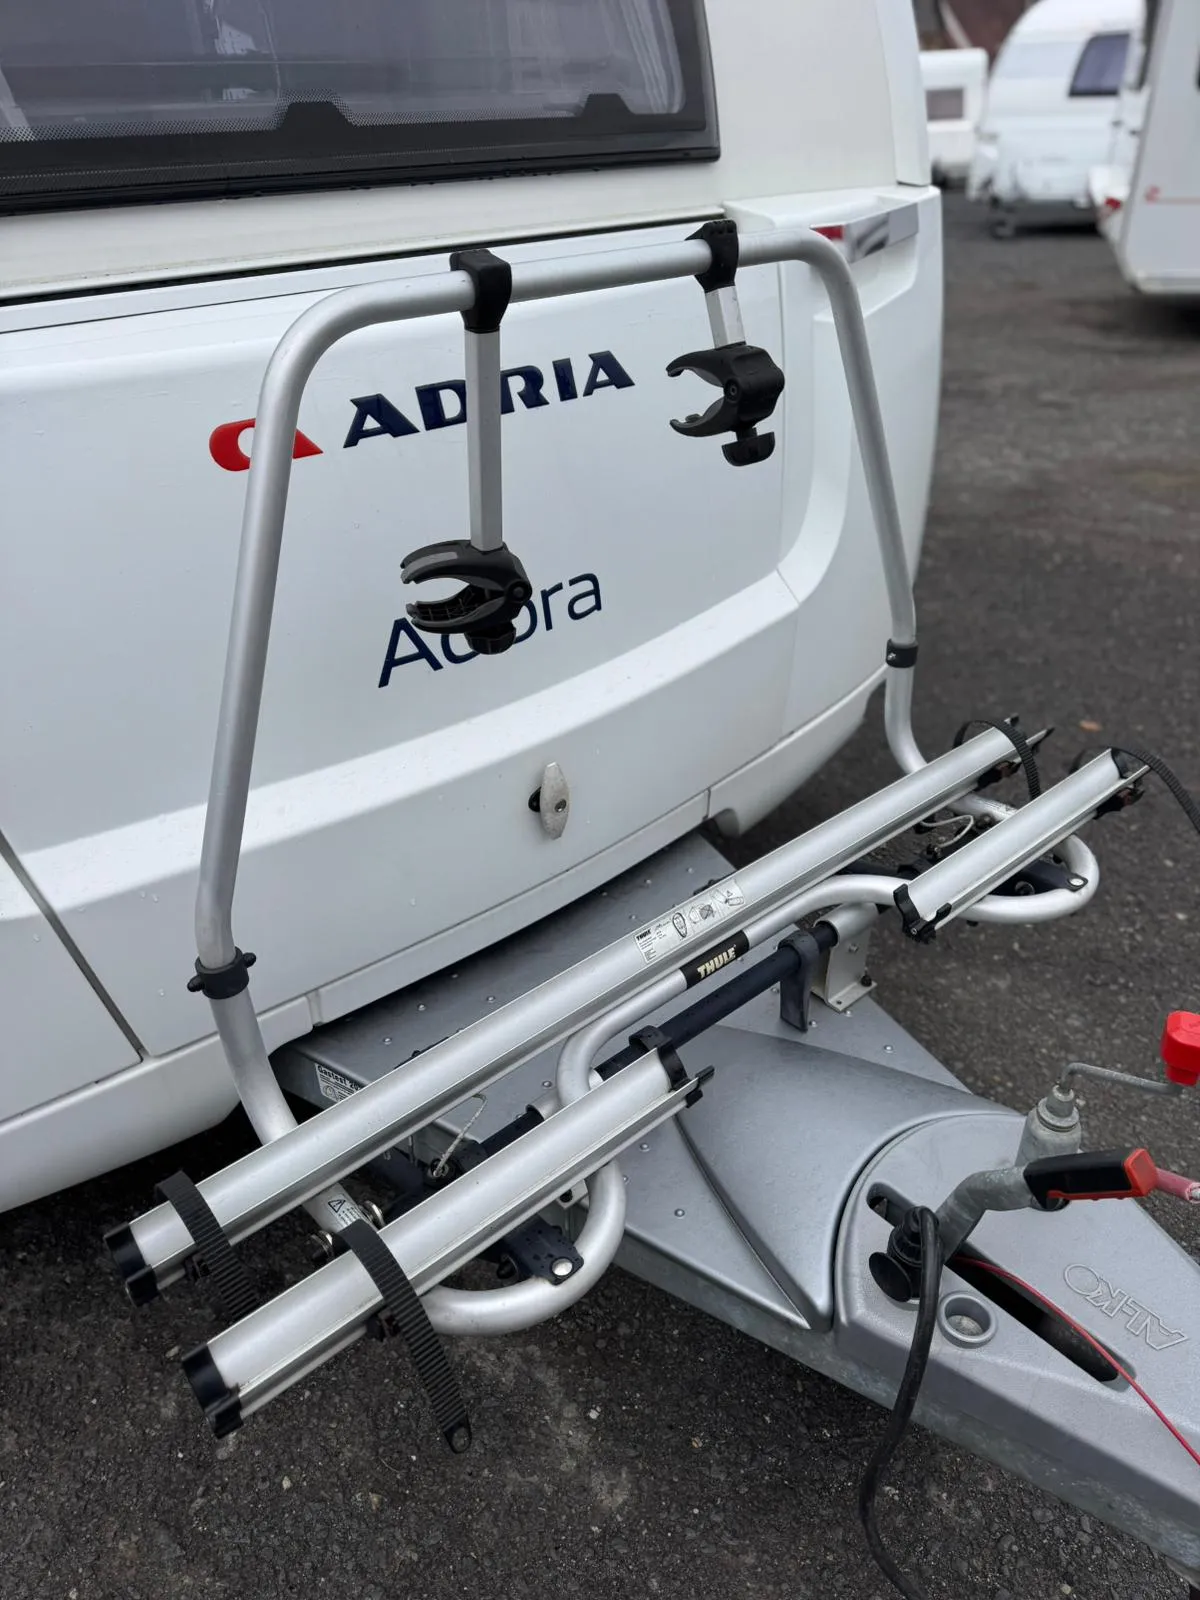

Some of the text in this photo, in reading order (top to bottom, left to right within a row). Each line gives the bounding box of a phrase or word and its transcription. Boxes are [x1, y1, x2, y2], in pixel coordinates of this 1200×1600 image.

[343, 350, 636, 448] ADRIA
[378, 572, 602, 689] Ara
[697, 946, 736, 979] THULE
